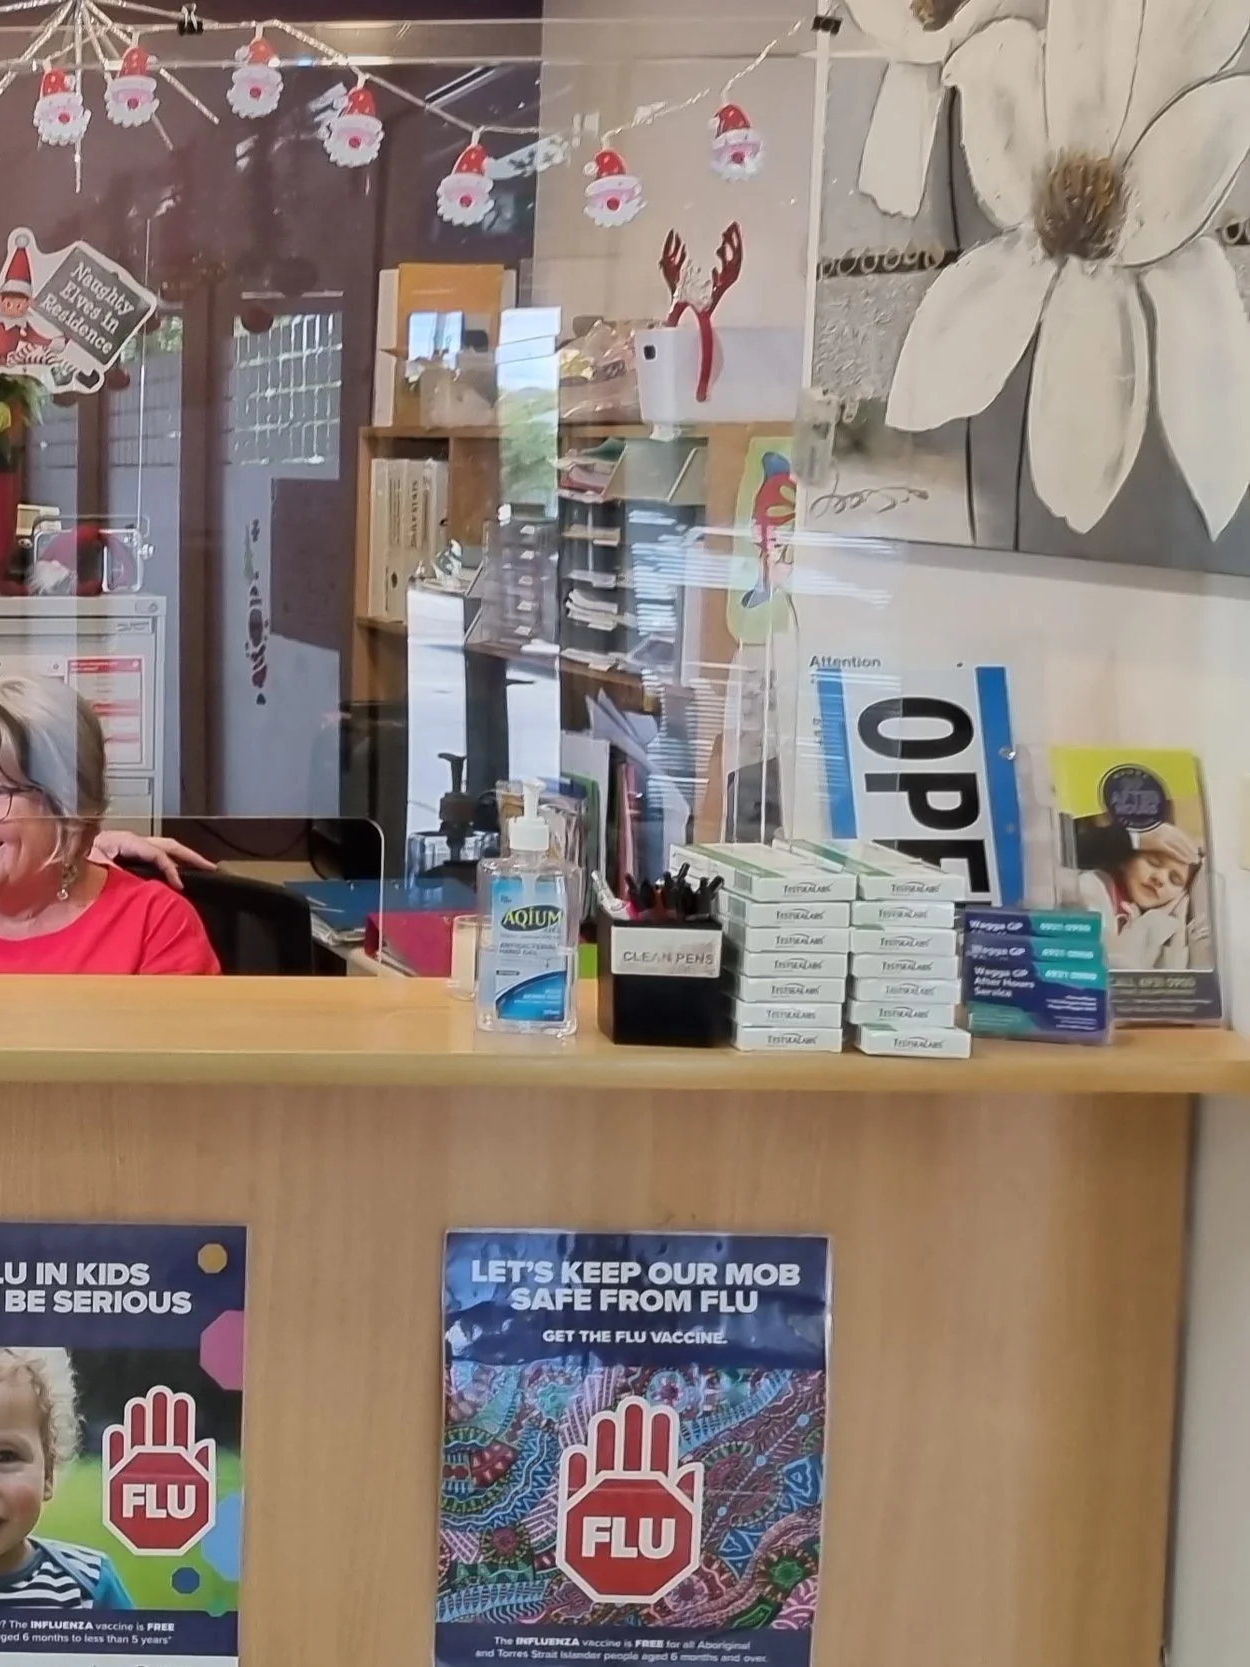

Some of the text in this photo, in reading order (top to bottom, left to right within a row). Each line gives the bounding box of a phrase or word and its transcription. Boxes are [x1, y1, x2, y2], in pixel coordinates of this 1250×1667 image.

[70, 261, 135, 315] Naughty
[59, 281, 119, 334] Elves in
[40, 293, 113, 354] Residence
[810, 655, 881, 669] Attention
[503, 907, 562, 928] AQIUM
[623, 951, 714, 965] CLEAN PENS
[974, 967, 1028, 979] Wagga GP
[974, 987, 1012, 997] Service
[36, 1262, 67, 1285] IN
[76, 1263, 150, 1286] KIDS
[471, 1259, 801, 1287] LET’S KEEP OUR MOB
[5, 1289, 45, 1313] BE
[53, 1290, 192, 1314] SERIOUS
[510, 1288, 758, 1314] SAFE FROM FLU
[542, 1330, 728, 1345] GET THE FLU VACCINE.
[122, 1483, 196, 1519] FLU
[581, 1516, 676, 1559] FLU
[9, 1620, 28, 1629] The
[30, 1620, 93, 1630] INFLUENZA
[96, 1622, 133, 1631] vaccine
[136, 1622, 144, 1631] is
[147, 1623, 174, 1631] FREE
[22, 1633, 29, 1641] 6
[32, 1633, 69, 1642] months
[72, 1634, 81, 1642] to
[84, 1634, 104, 1643] less
[107, 1635, 129, 1643] than
[132, 1635, 138, 1643] 5
[494, 1636, 750, 1651] The INFLUENZA vaccine is FREE for all Aboriginal
[475, 1649, 767, 1663] and Torres Strait Islander people aged 6 months and over.
